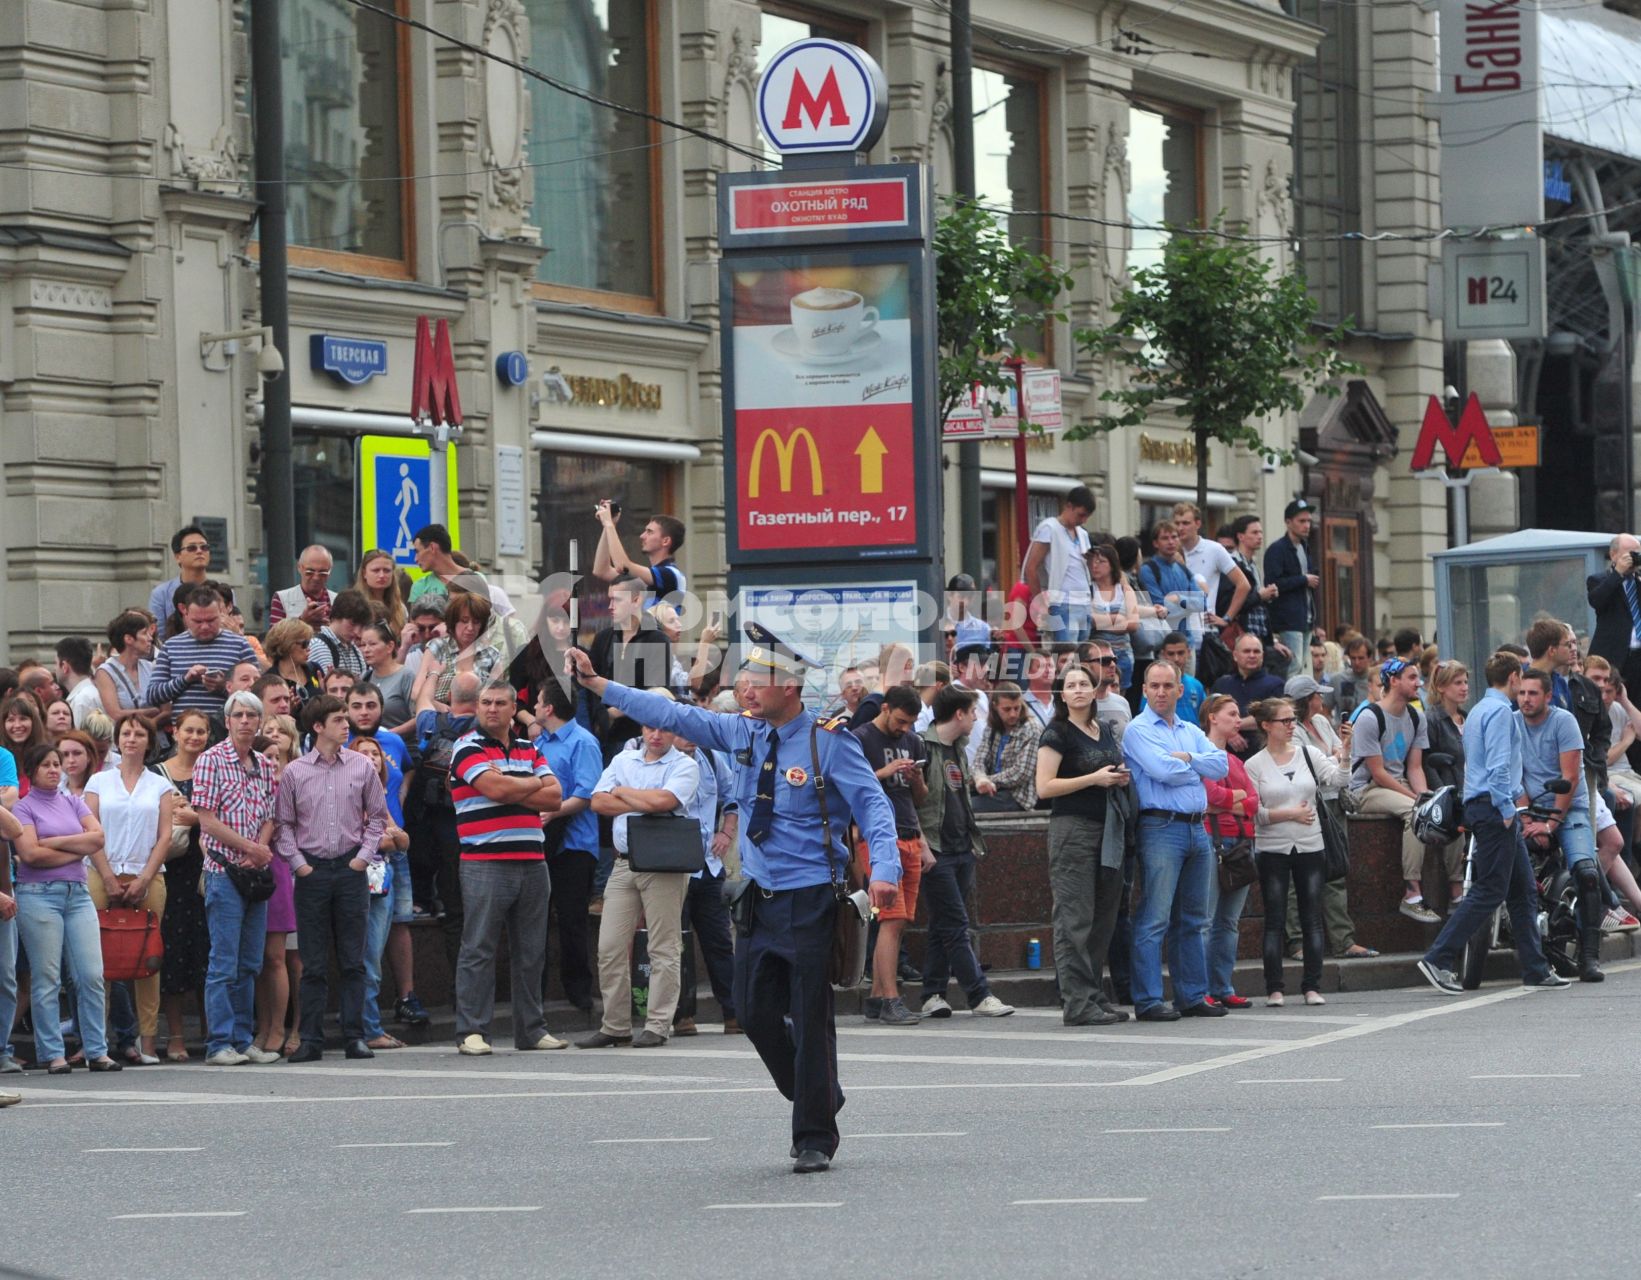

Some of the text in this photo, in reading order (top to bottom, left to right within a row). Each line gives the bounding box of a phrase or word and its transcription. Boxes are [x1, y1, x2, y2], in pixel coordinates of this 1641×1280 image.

[771, 196, 868, 213] ОХОТНЫЙ РЯД
[331, 345, 379, 365] ТВЕРСКАЯ
[748, 506, 908, 526] Газетный пер., 17
